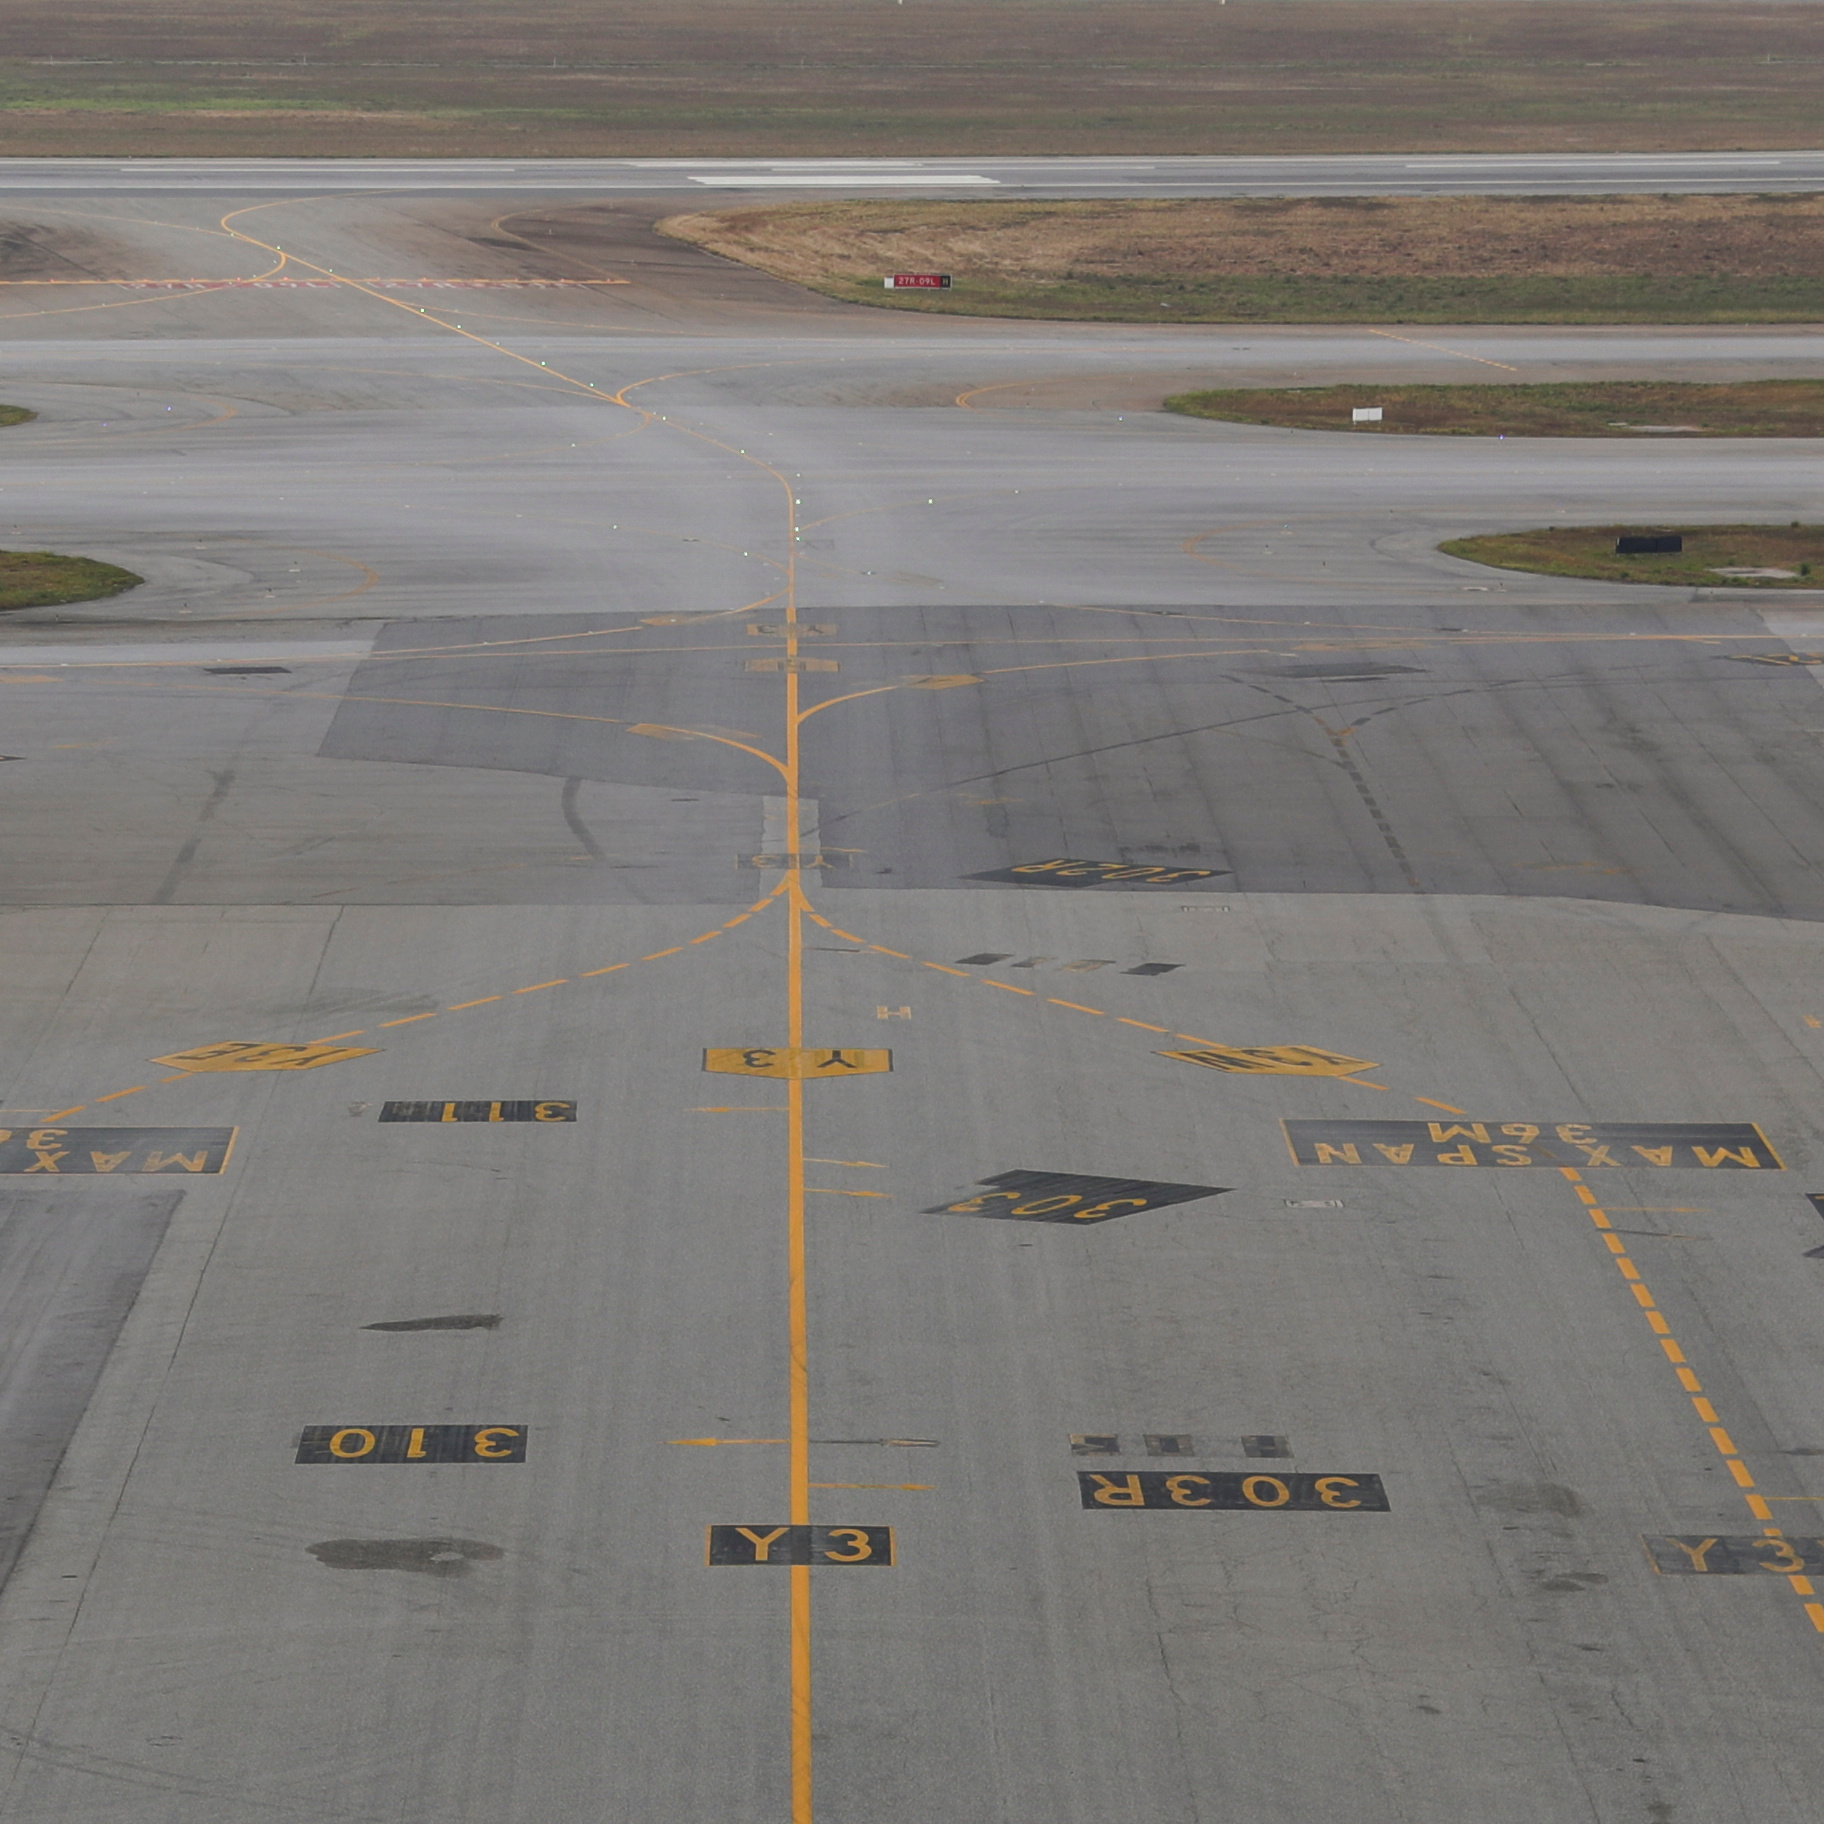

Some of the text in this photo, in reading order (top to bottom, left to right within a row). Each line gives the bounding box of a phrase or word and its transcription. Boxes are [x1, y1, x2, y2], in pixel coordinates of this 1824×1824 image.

[1012, 859, 1212, 884] 302R
[169, 1042, 349, 1066] Y3E
[441, 1102, 572, 1123] 311
[1428, 1123, 1597, 1144] 36M
[25, 1150, 209, 1172] MAX
[1314, 1142, 1762, 1168] MAX SPAN
[949, 1191, 1148, 1220] 303
[329, 1427, 522, 1460] 310
[1090, 1474, 1363, 1510] 303R
